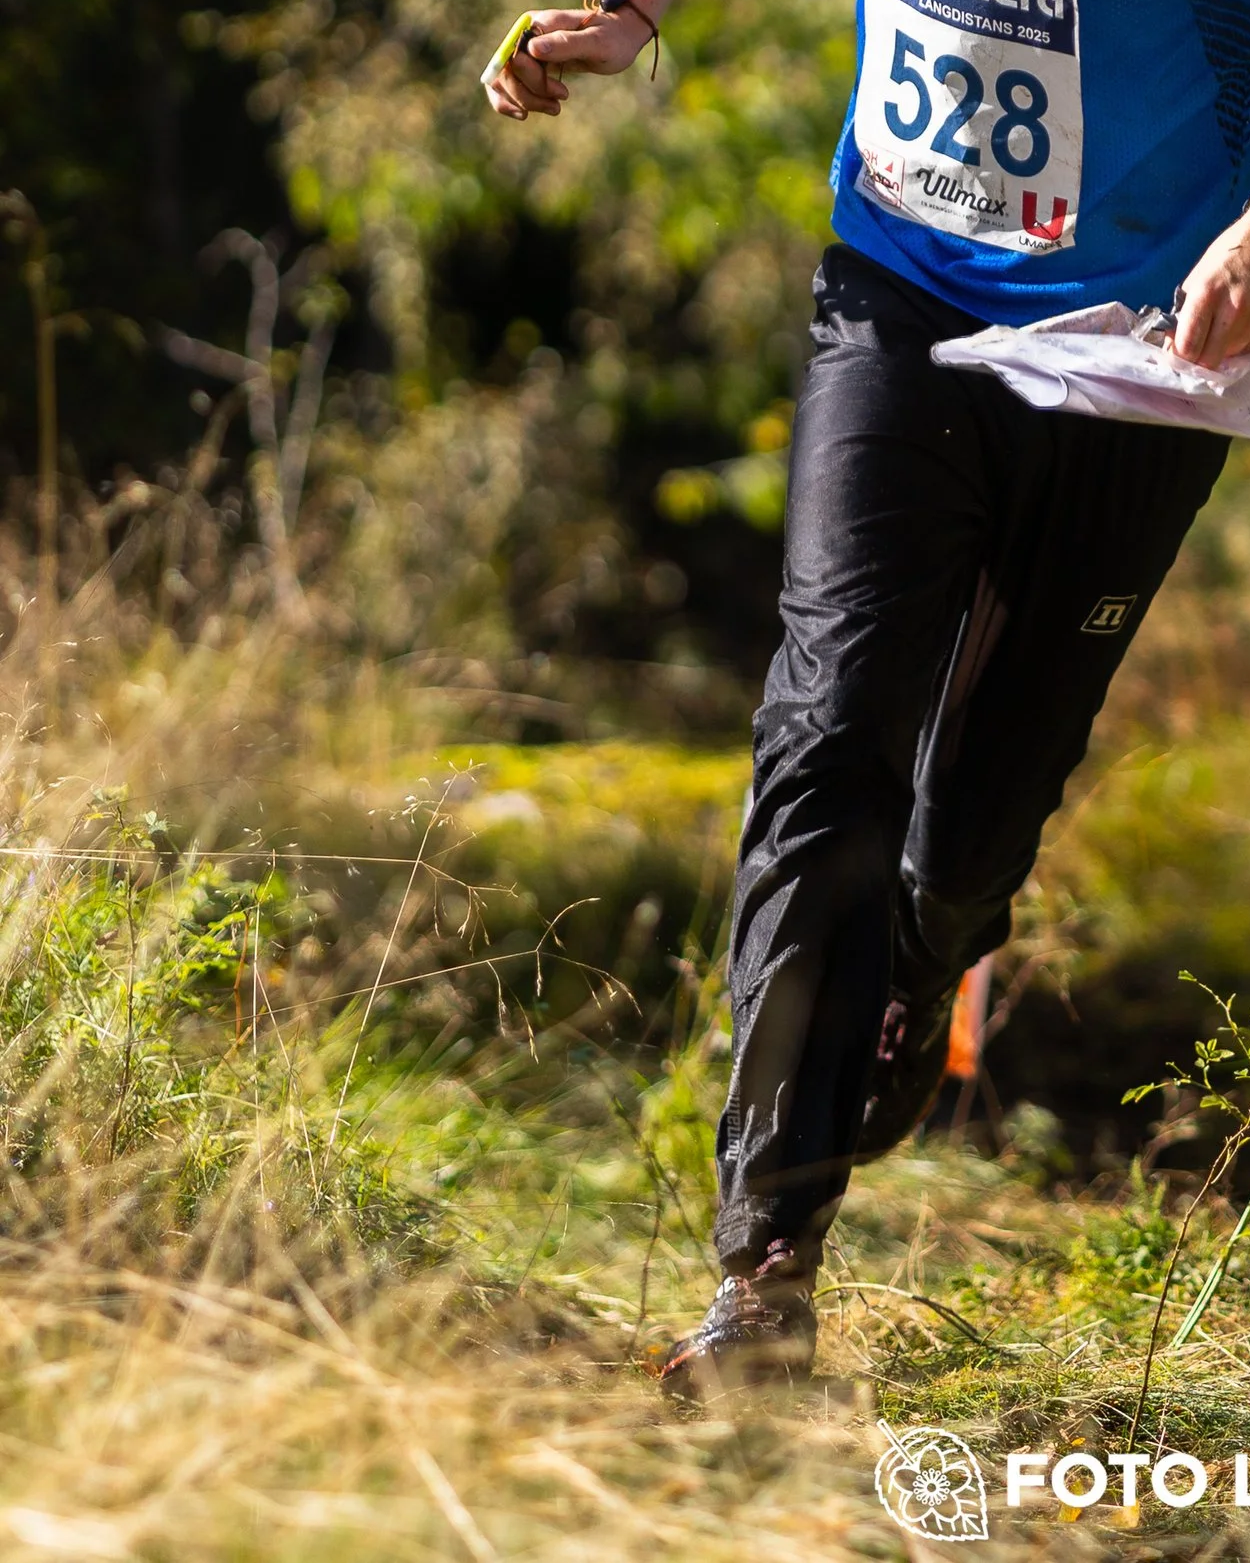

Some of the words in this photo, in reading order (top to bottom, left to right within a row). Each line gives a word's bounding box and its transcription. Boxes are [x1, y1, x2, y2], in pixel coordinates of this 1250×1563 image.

[1017, 25, 1051, 44] 2025
[883, 29, 1051, 177] 528
[916, 167, 1007, 217] Ullmax
[1022, 190, 1068, 241] U
